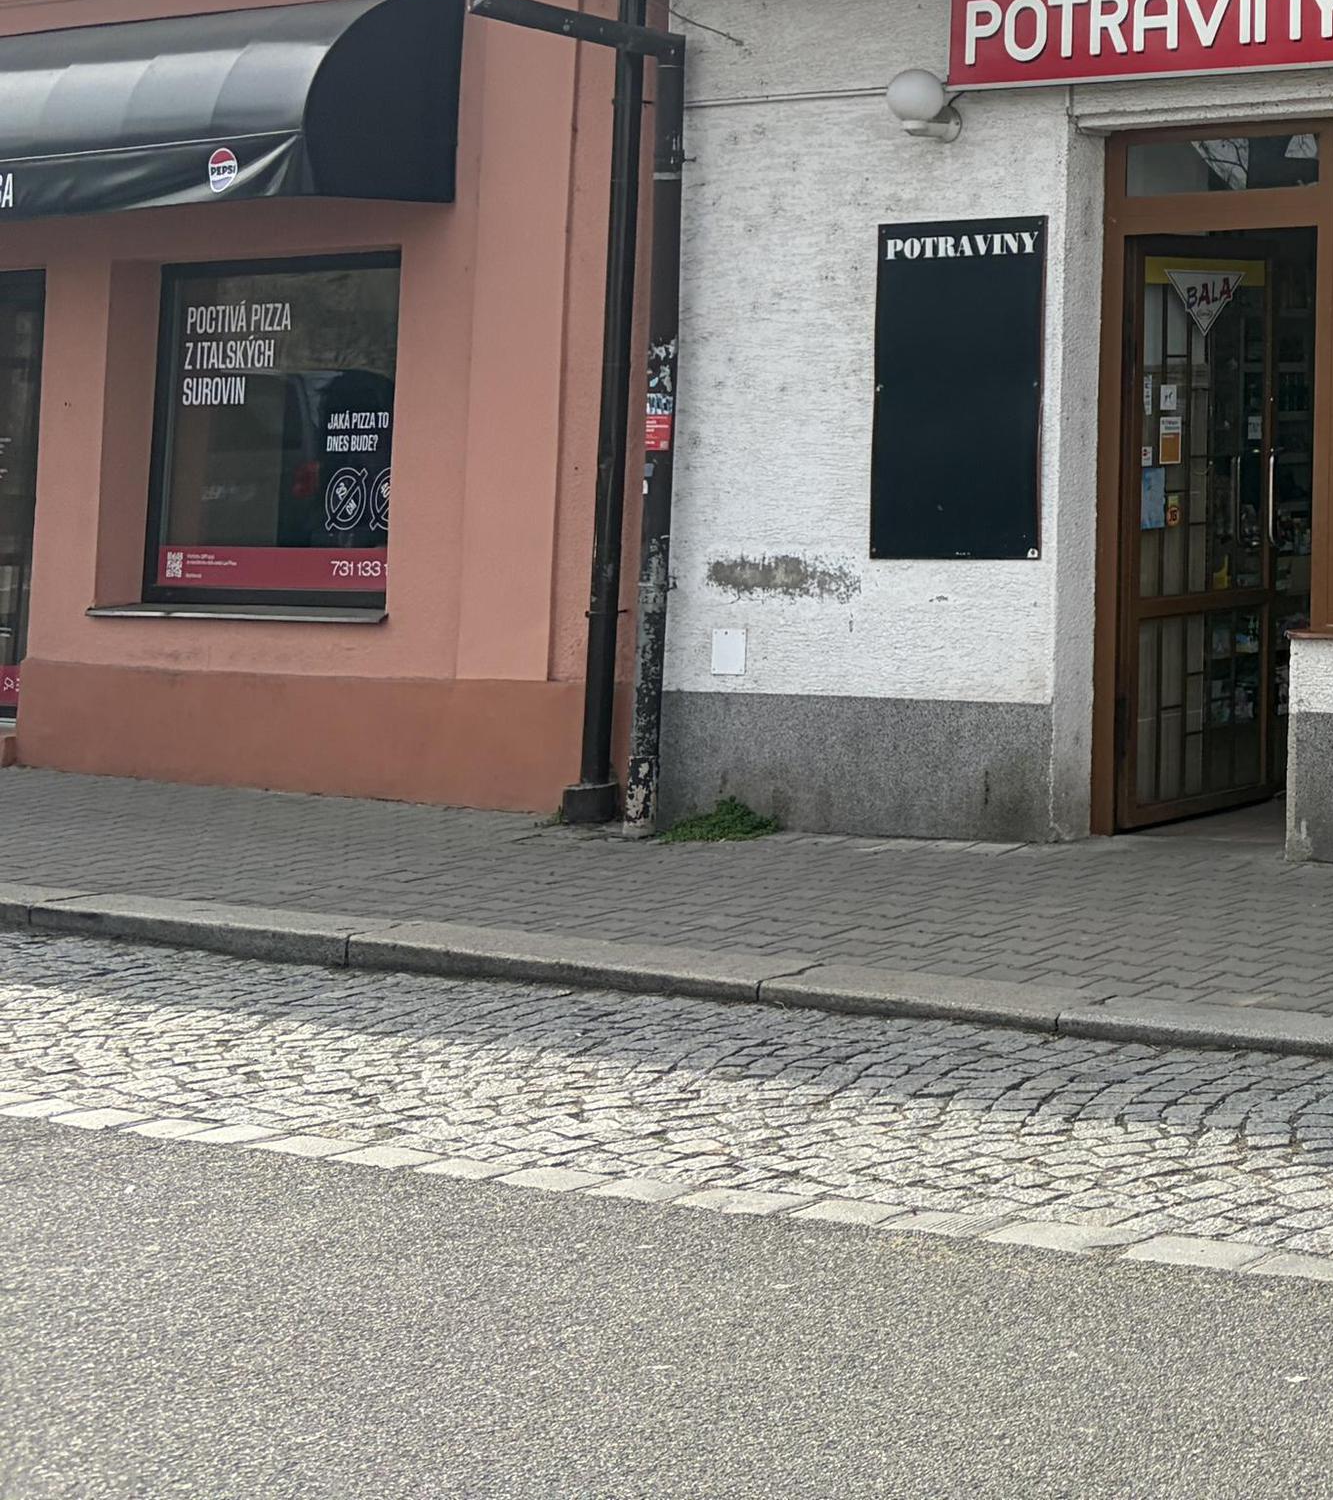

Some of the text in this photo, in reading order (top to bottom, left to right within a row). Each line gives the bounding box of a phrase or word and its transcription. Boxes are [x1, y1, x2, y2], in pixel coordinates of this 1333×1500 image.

[210, 164, 236, 176] PEPSI
[885, 231, 1039, 261] POTRAVINY
[1186, 276, 1232, 309] BALA
[186, 300, 292, 335] POCTIVÁ PIZZA
[184, 335, 275, 370] Z ITALSKÝCH
[182, 376, 246, 406] SUROVIN
[327, 410, 390, 430] JAKÁ PIZZA TO
[326, 434, 379, 452] DNES BUDE?
[330, 560, 354, 578] 731
[356, 560, 381, 578] 133
